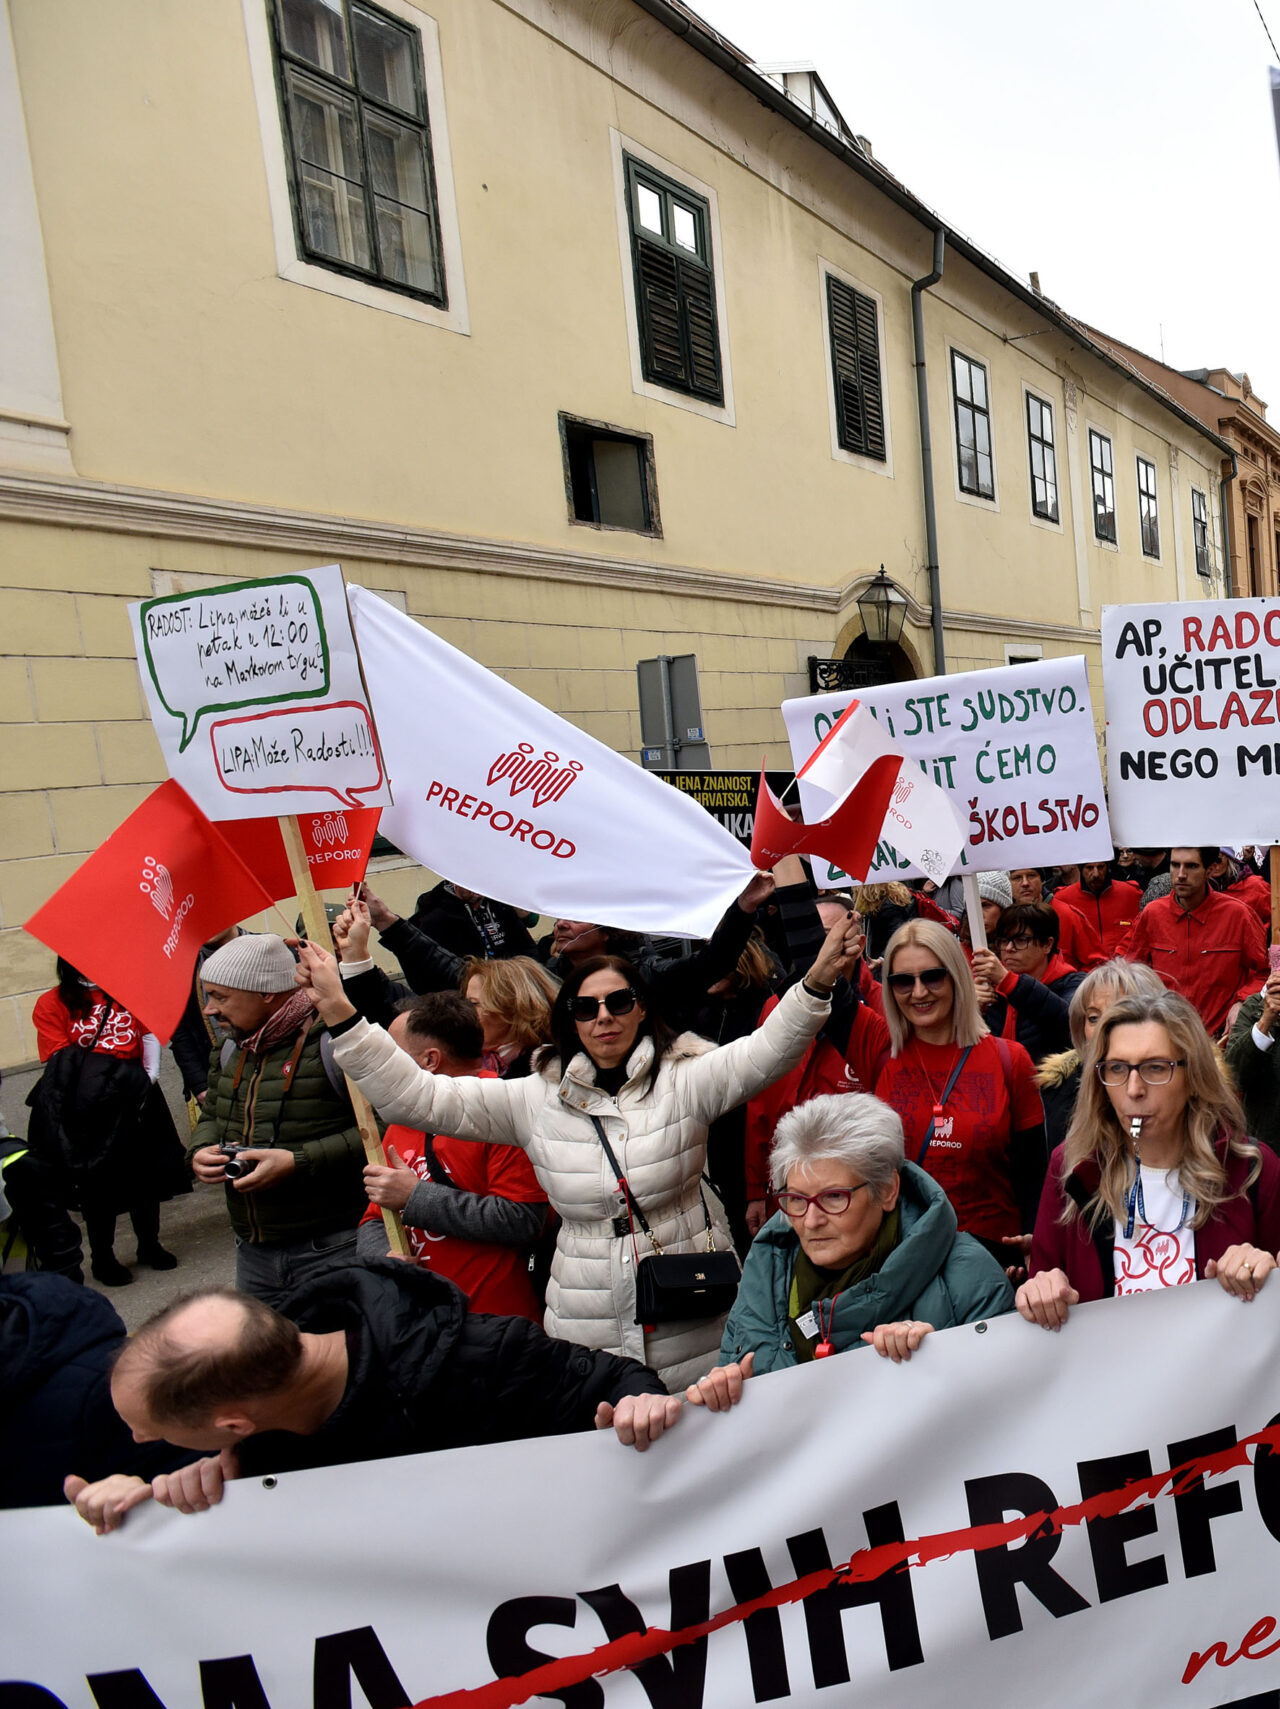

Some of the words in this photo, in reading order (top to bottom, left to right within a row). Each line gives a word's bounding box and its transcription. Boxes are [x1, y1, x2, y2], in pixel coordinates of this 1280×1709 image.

[197, 629, 243, 669] petak
[263, 621, 308, 648] 12:00
[1115, 618, 1167, 659] AP,
[205, 672, 223, 688] na
[904, 693, 951, 736] STE
[961, 686, 1086, 732] SUDSTVO.
[703, 776, 755, 793] ZNANOST,
[975, 741, 1057, 784] ĆEMO
[1120, 747, 1219, 780] NEGO
[426, 780, 576, 859] PREPOROD
[694, 792, 752, 807] HRVATSKA.
[968, 795, 1100, 846] ŠKOLSTVO
[163, 893, 194, 959] PREPOROD
[486, 1500, 924, 1709] SVIH
